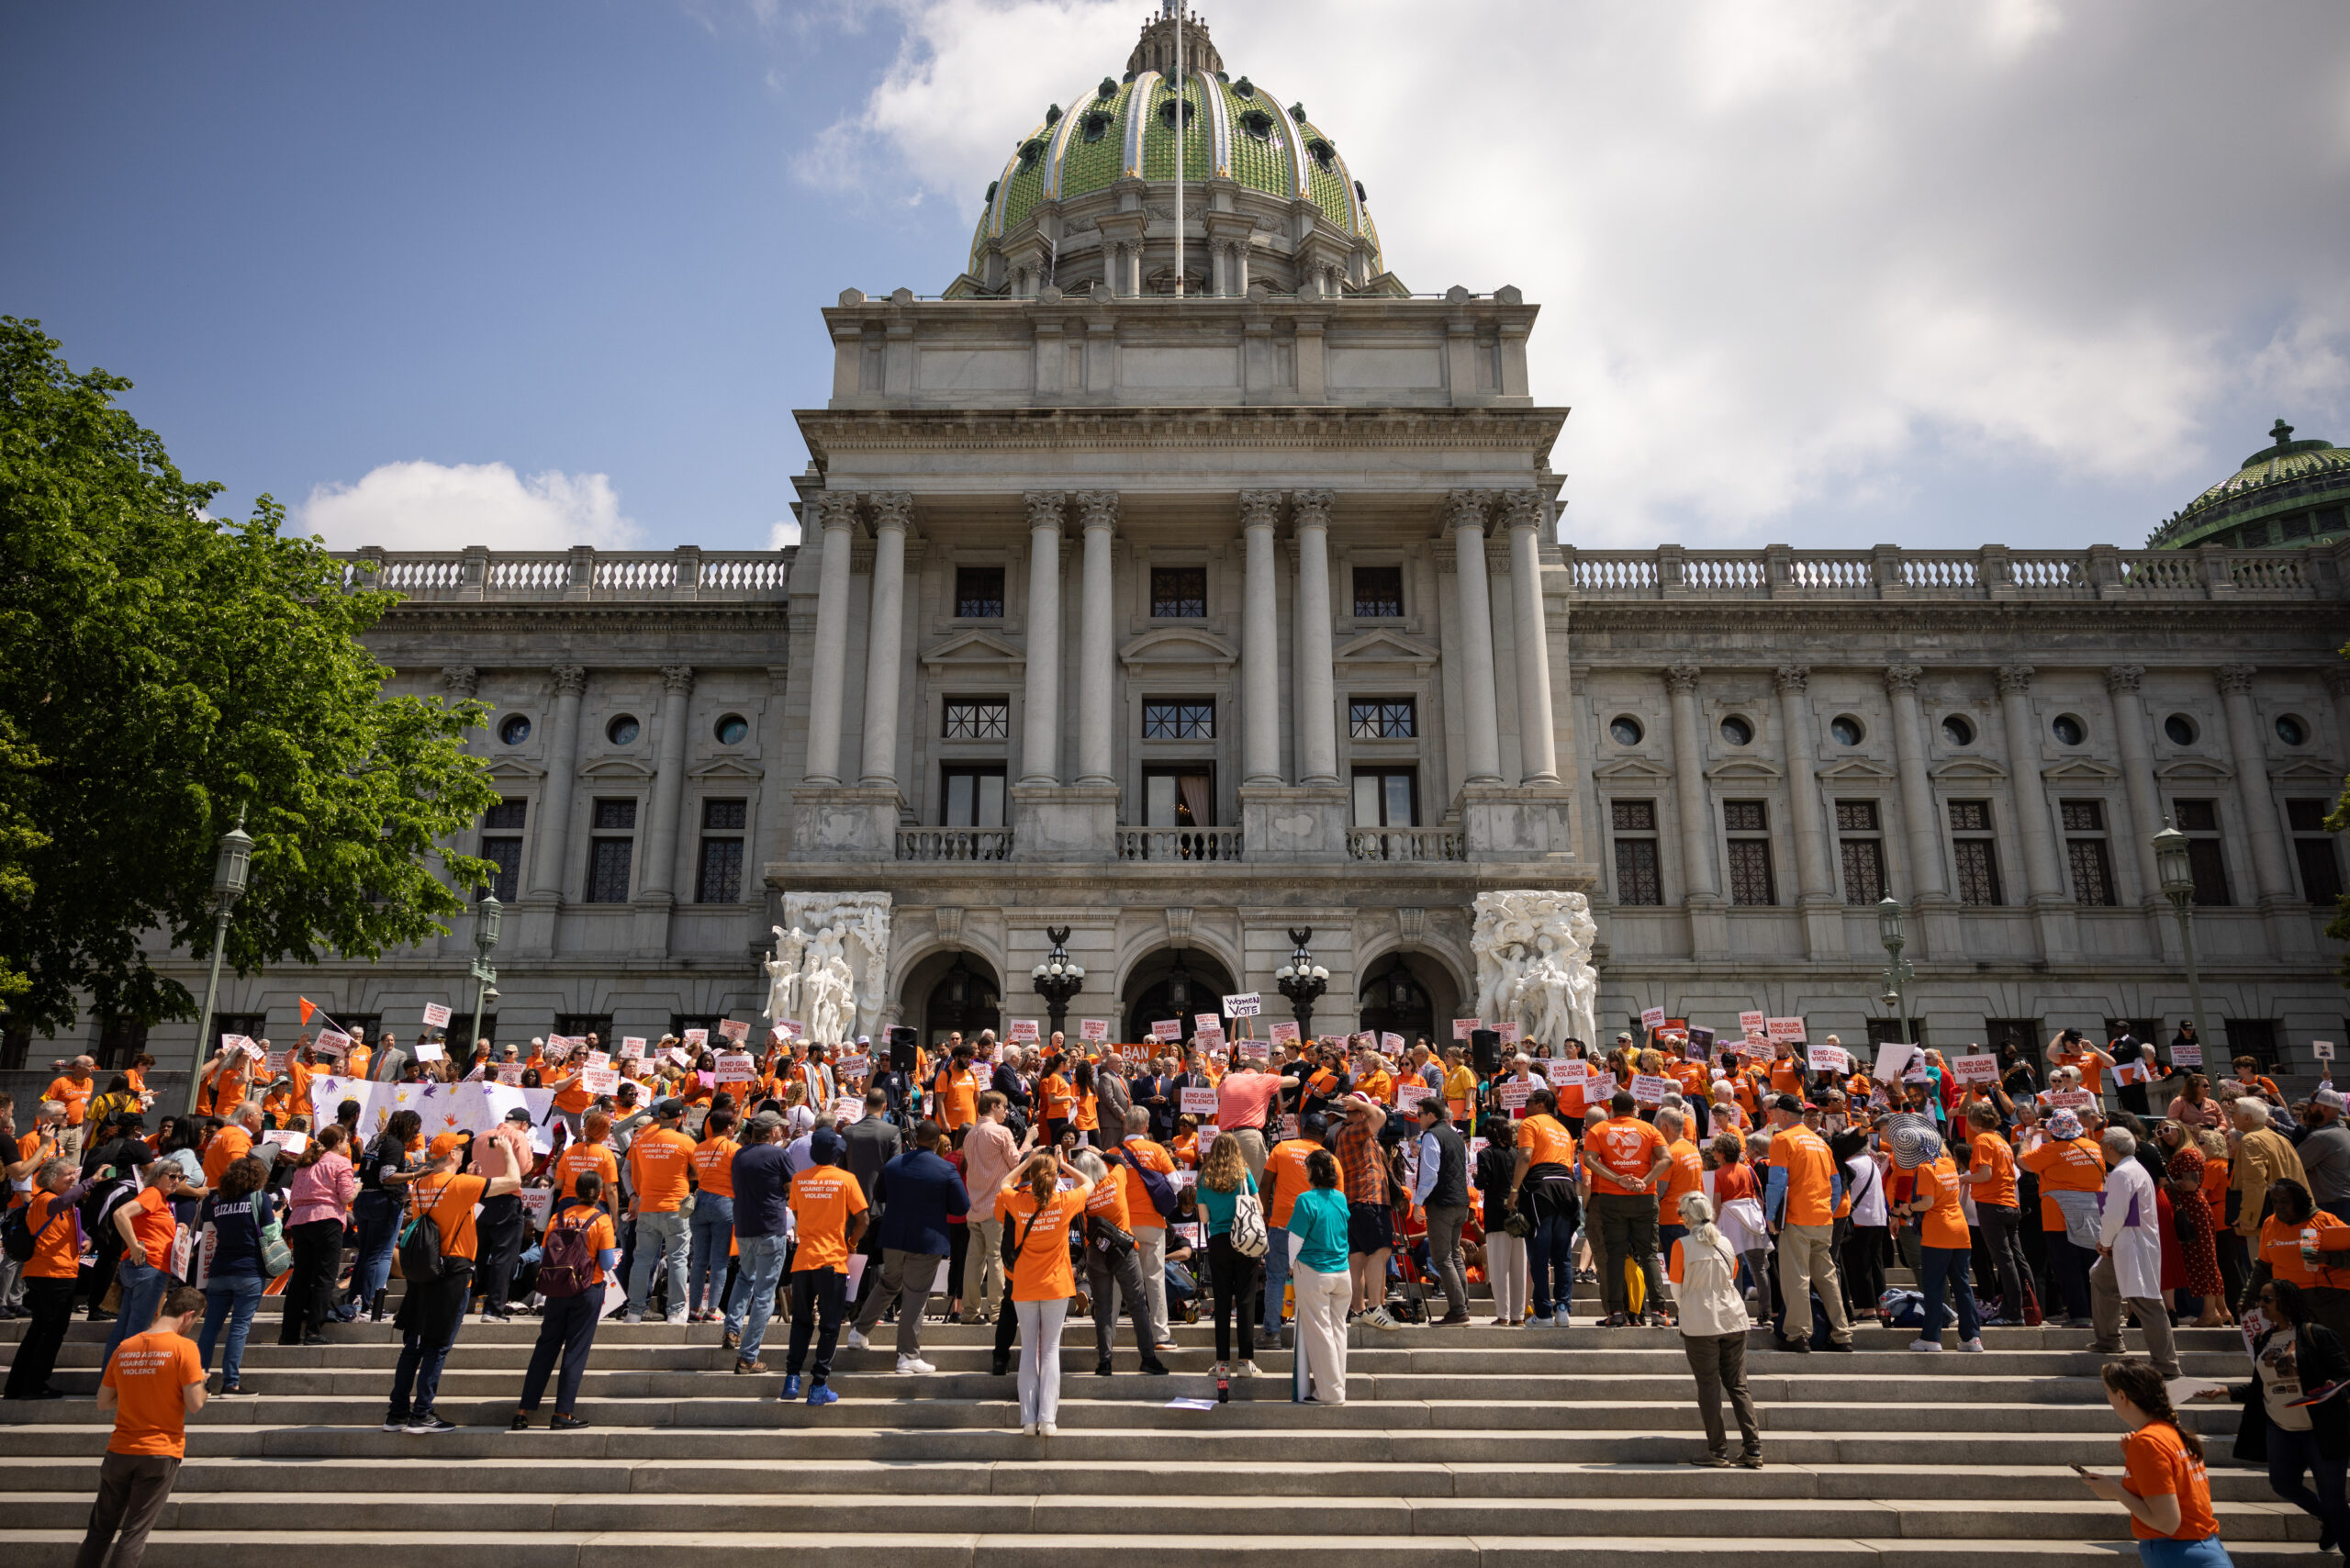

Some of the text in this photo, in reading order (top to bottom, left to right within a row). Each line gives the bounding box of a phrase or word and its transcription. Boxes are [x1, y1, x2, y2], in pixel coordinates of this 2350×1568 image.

[1228, 1006, 1258, 1015] VOTE
[319, 1038, 347, 1049] VIOLENC
[1122, 1046, 1148, 1059] BAN
[1812, 1056, 1845, 1065] VIOLENCE
[1587, 1080, 1612, 1088] SWITCHES
[1102, 1183, 1116, 1193] STAND
[1086, 1196, 1103, 1204] GAINST
[1089, 1198, 1114, 1210] VIOLENCE
[214, 1202, 252, 1216] ELIZALDE
[204, 1230, 216, 1279] SAFE GUN
